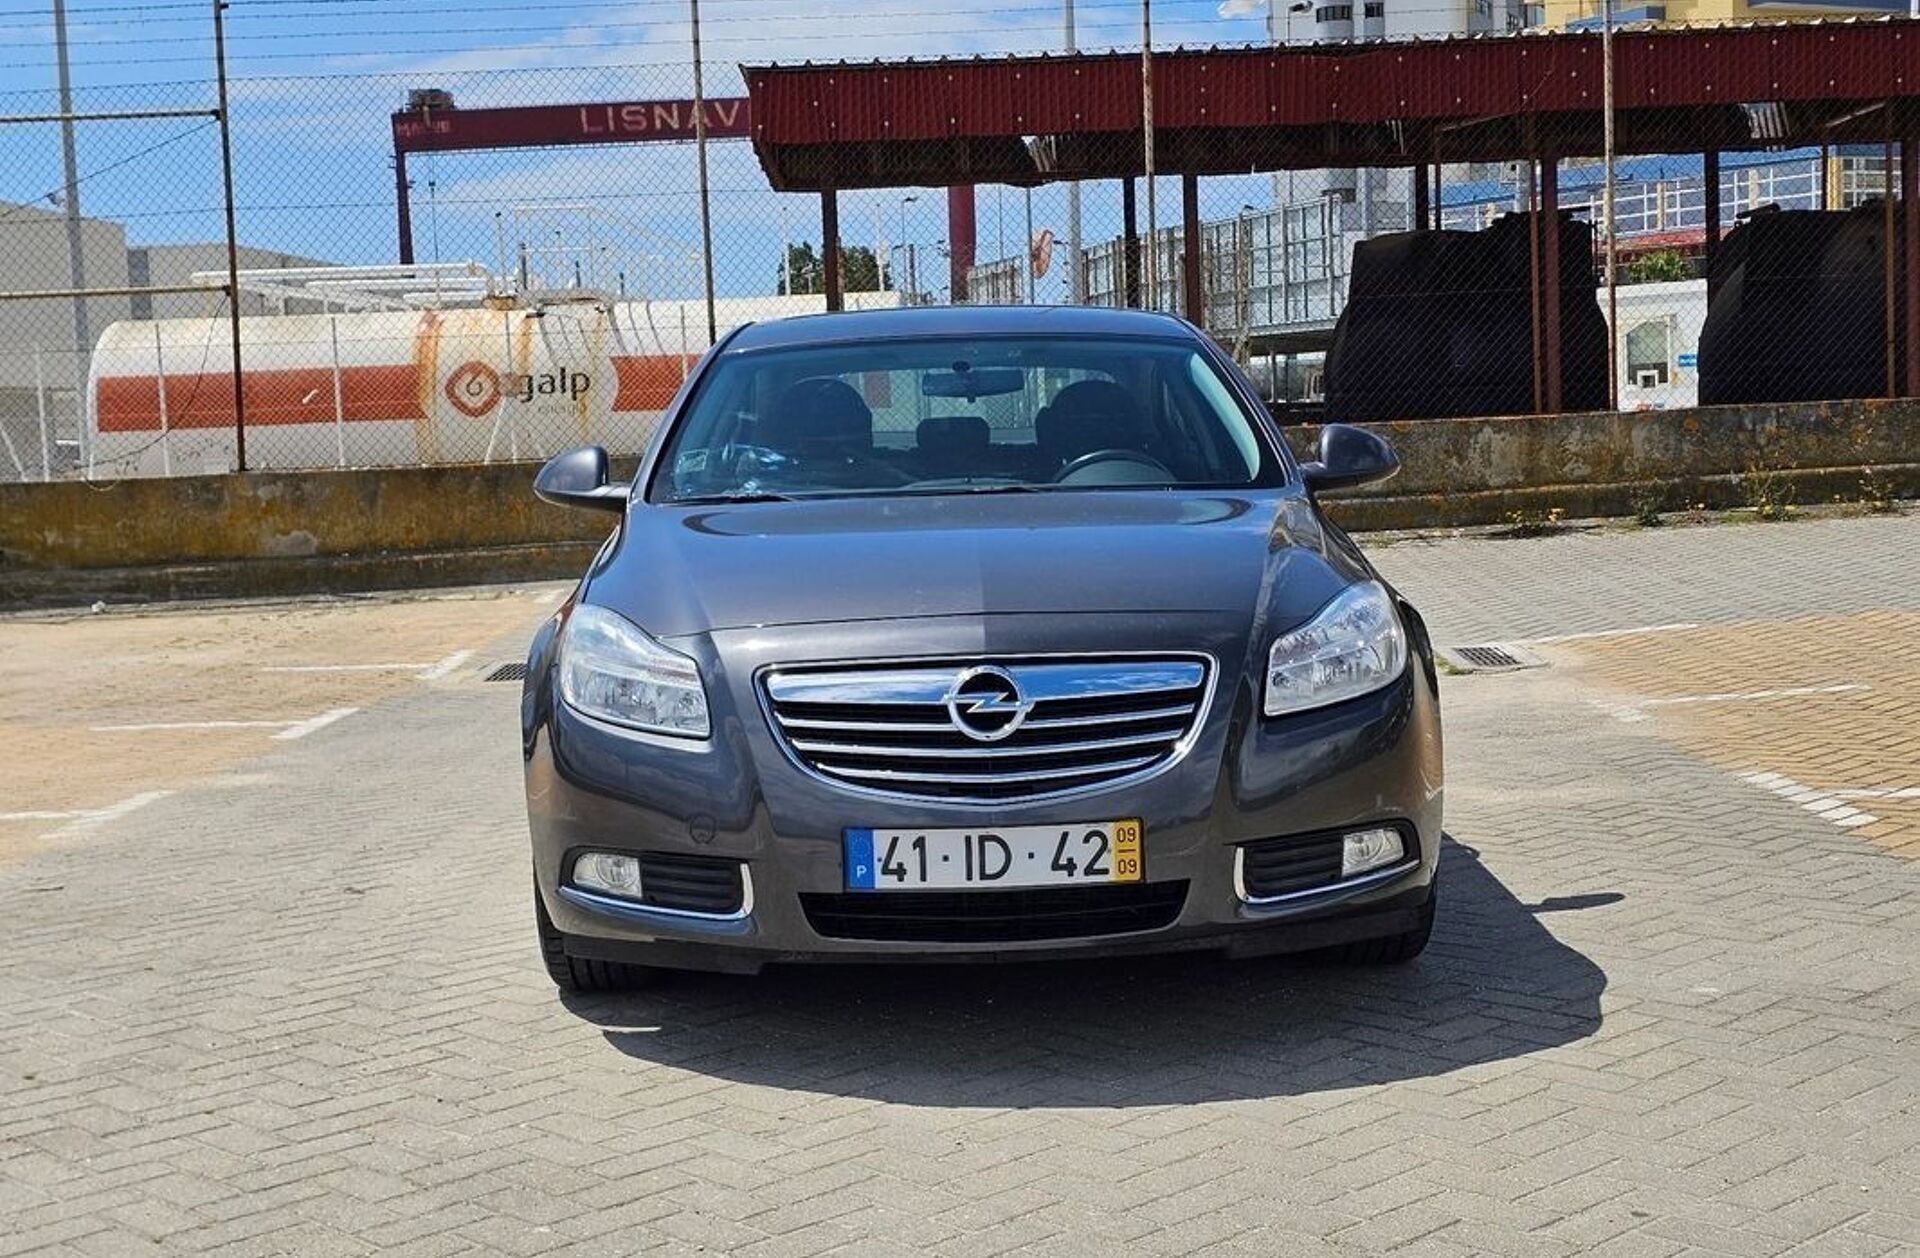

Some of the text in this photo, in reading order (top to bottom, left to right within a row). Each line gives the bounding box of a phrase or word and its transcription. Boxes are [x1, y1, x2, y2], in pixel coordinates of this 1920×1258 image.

[515, 366, 591, 403] galp
[1116, 826, 1137, 843] 09
[856, 865, 867, 878] P
[1117, 858, 1137, 875] 09
